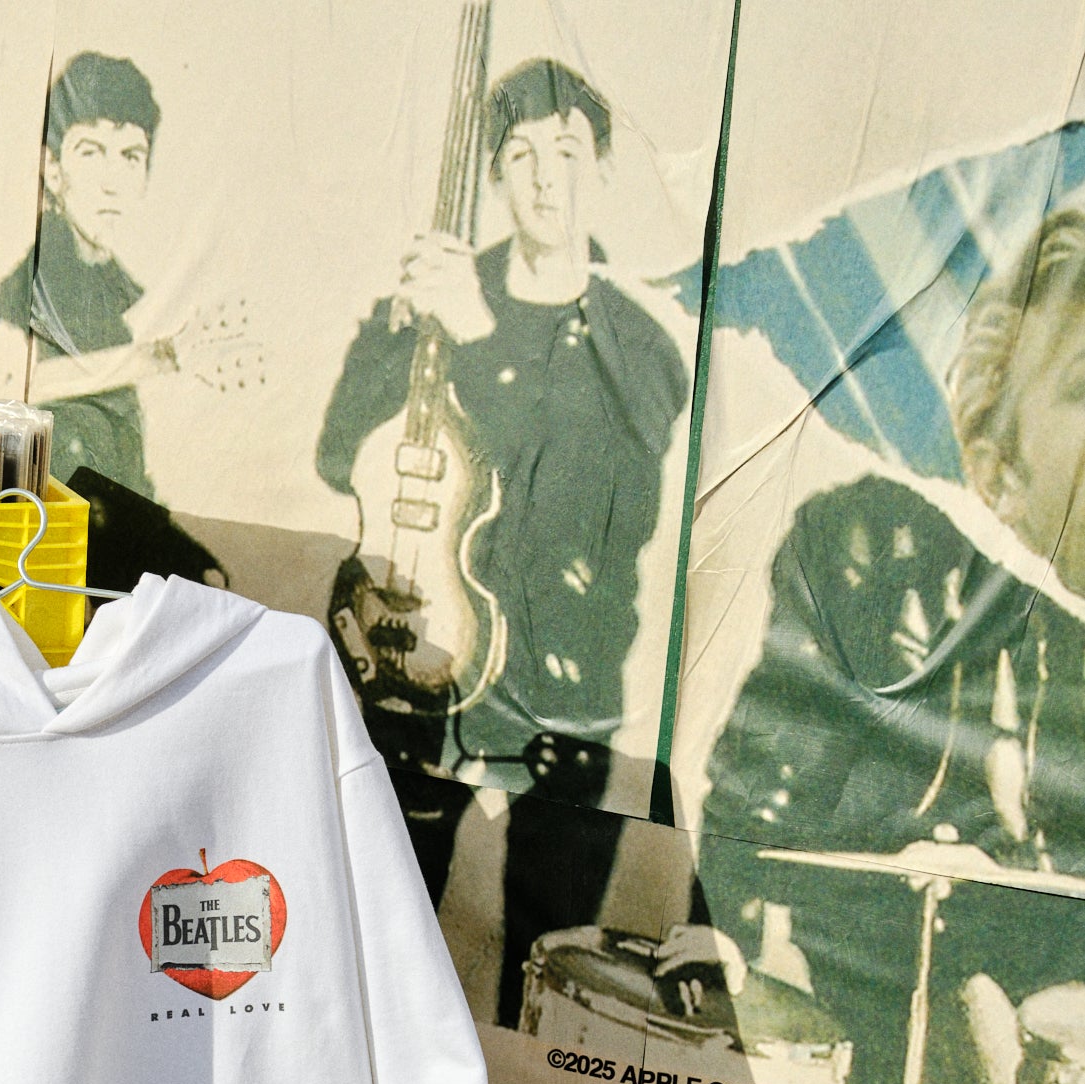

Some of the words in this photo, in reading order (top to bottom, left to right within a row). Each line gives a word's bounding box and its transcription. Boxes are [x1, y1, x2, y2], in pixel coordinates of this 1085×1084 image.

[200, 899, 220, 912] THE
[162, 904, 262, 951] BEATLES
[151, 1008, 205, 1022] REAL
[230, 1003, 285, 1015] LOVE
[547, 1048, 617, 1081] ©2025
